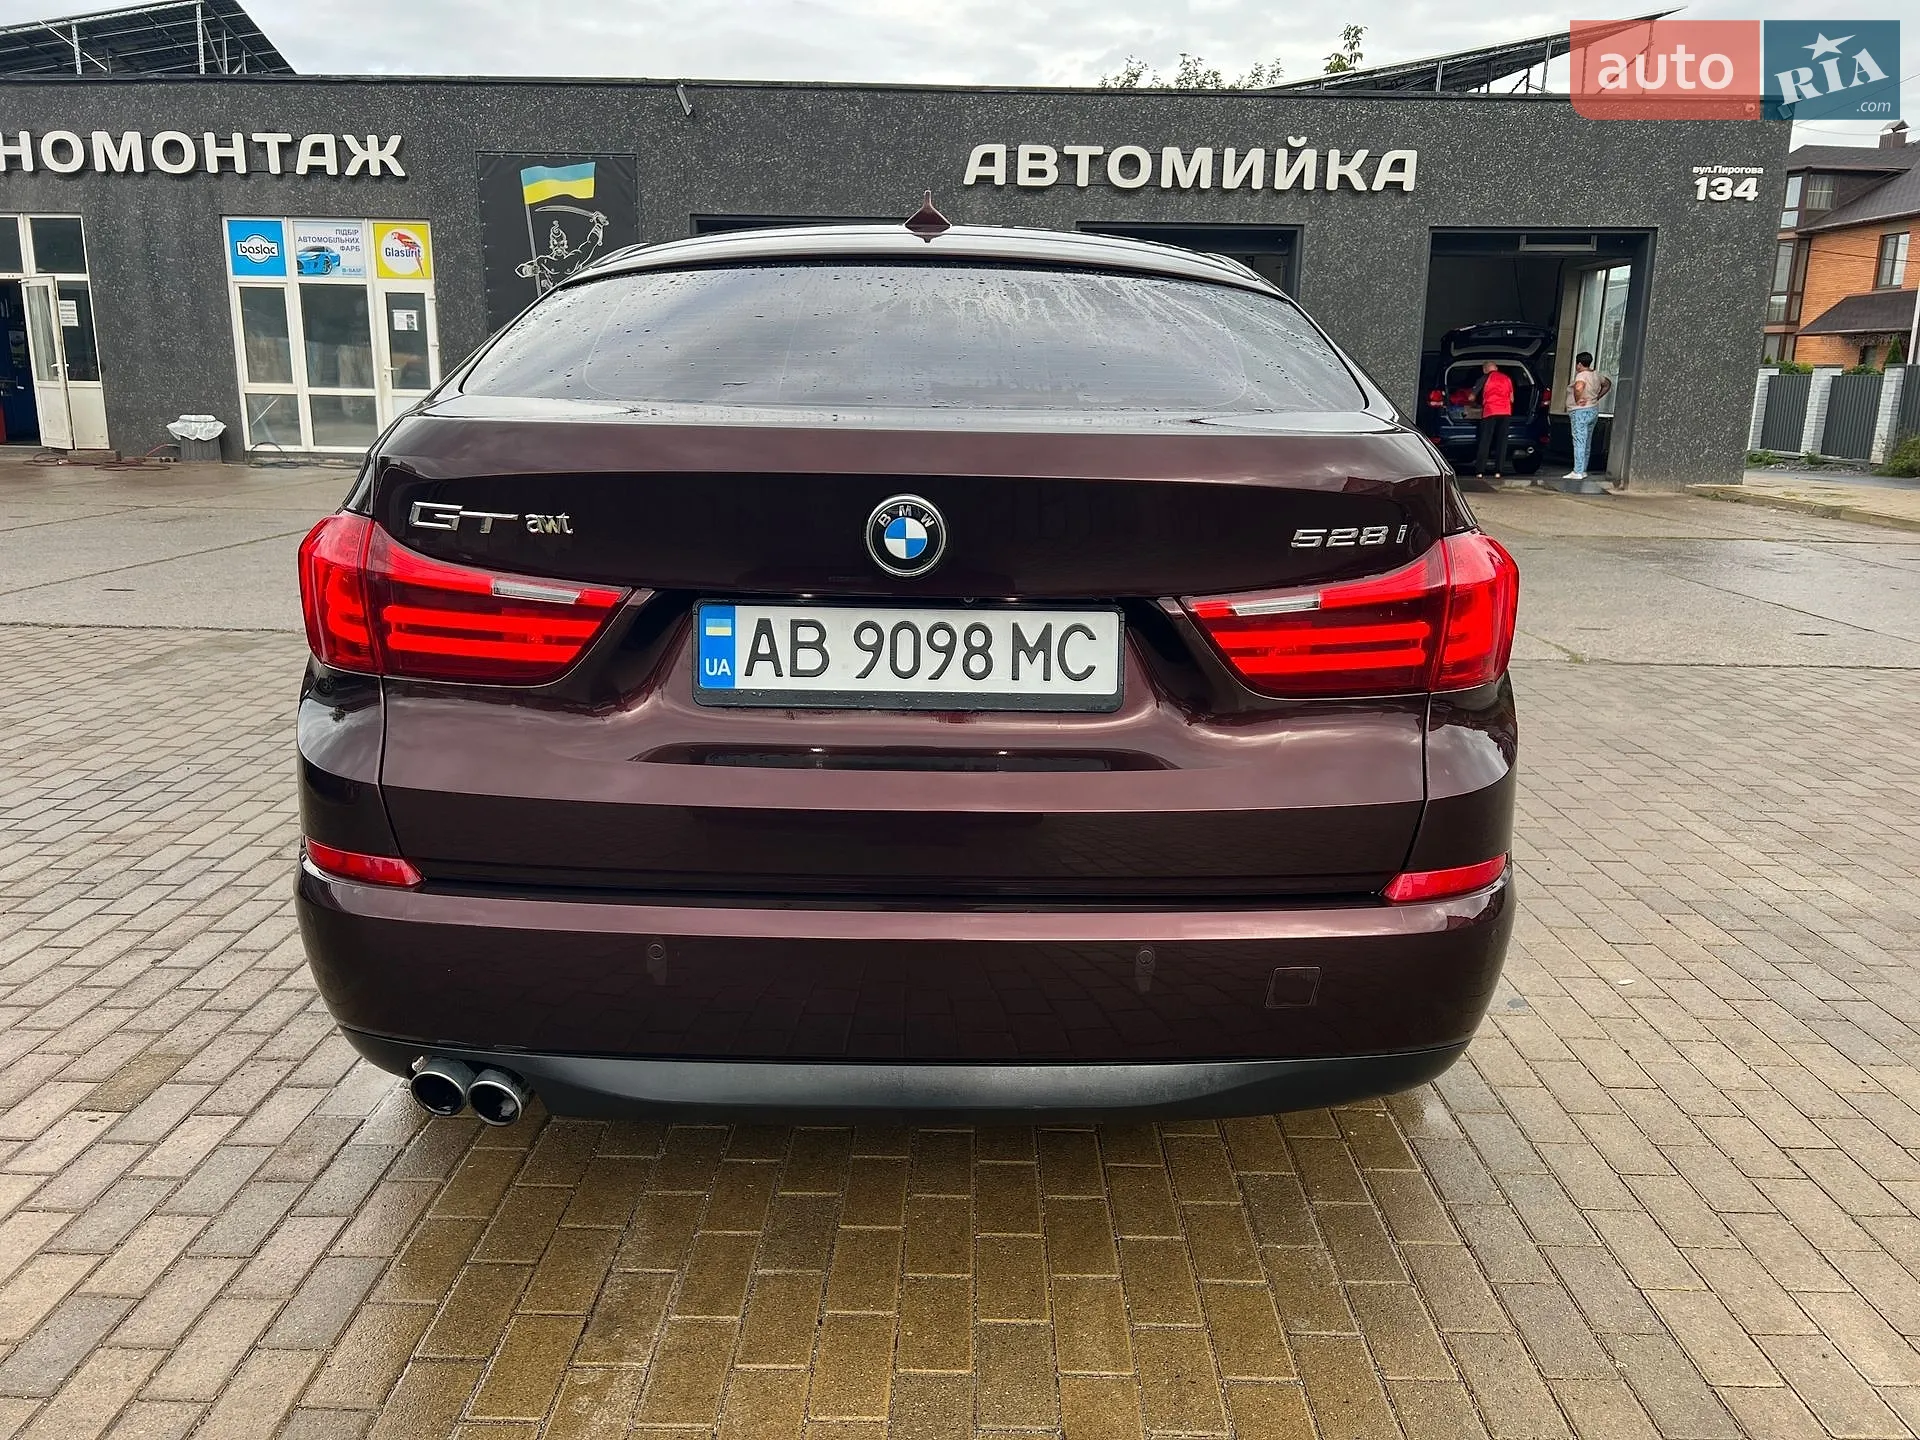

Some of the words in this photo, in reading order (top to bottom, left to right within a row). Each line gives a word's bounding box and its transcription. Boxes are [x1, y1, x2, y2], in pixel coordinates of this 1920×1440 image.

[0, 130, 406, 177] НОМОНТАЖ
[963, 135, 1418, 192] АВТОМИЙКА
[1694, 176, 1759, 201] 134
[297, 236, 360, 244] АВТОМОБІЛЬНИХ
[335, 228, 359, 236] ПІДБІР
[239, 243, 276, 255] baslac
[384, 247, 422, 258] Glasurit
[408, 501, 518, 534] GT
[525, 512, 574, 535] awt
[877, 504, 935, 528] BMW
[1290, 526, 1389, 548] 528
[744, 618, 830, 679] AB
[853, 620, 994, 681] 9098
[1011, 622, 1098, 682] MC
[705, 658, 731, 677] UA
